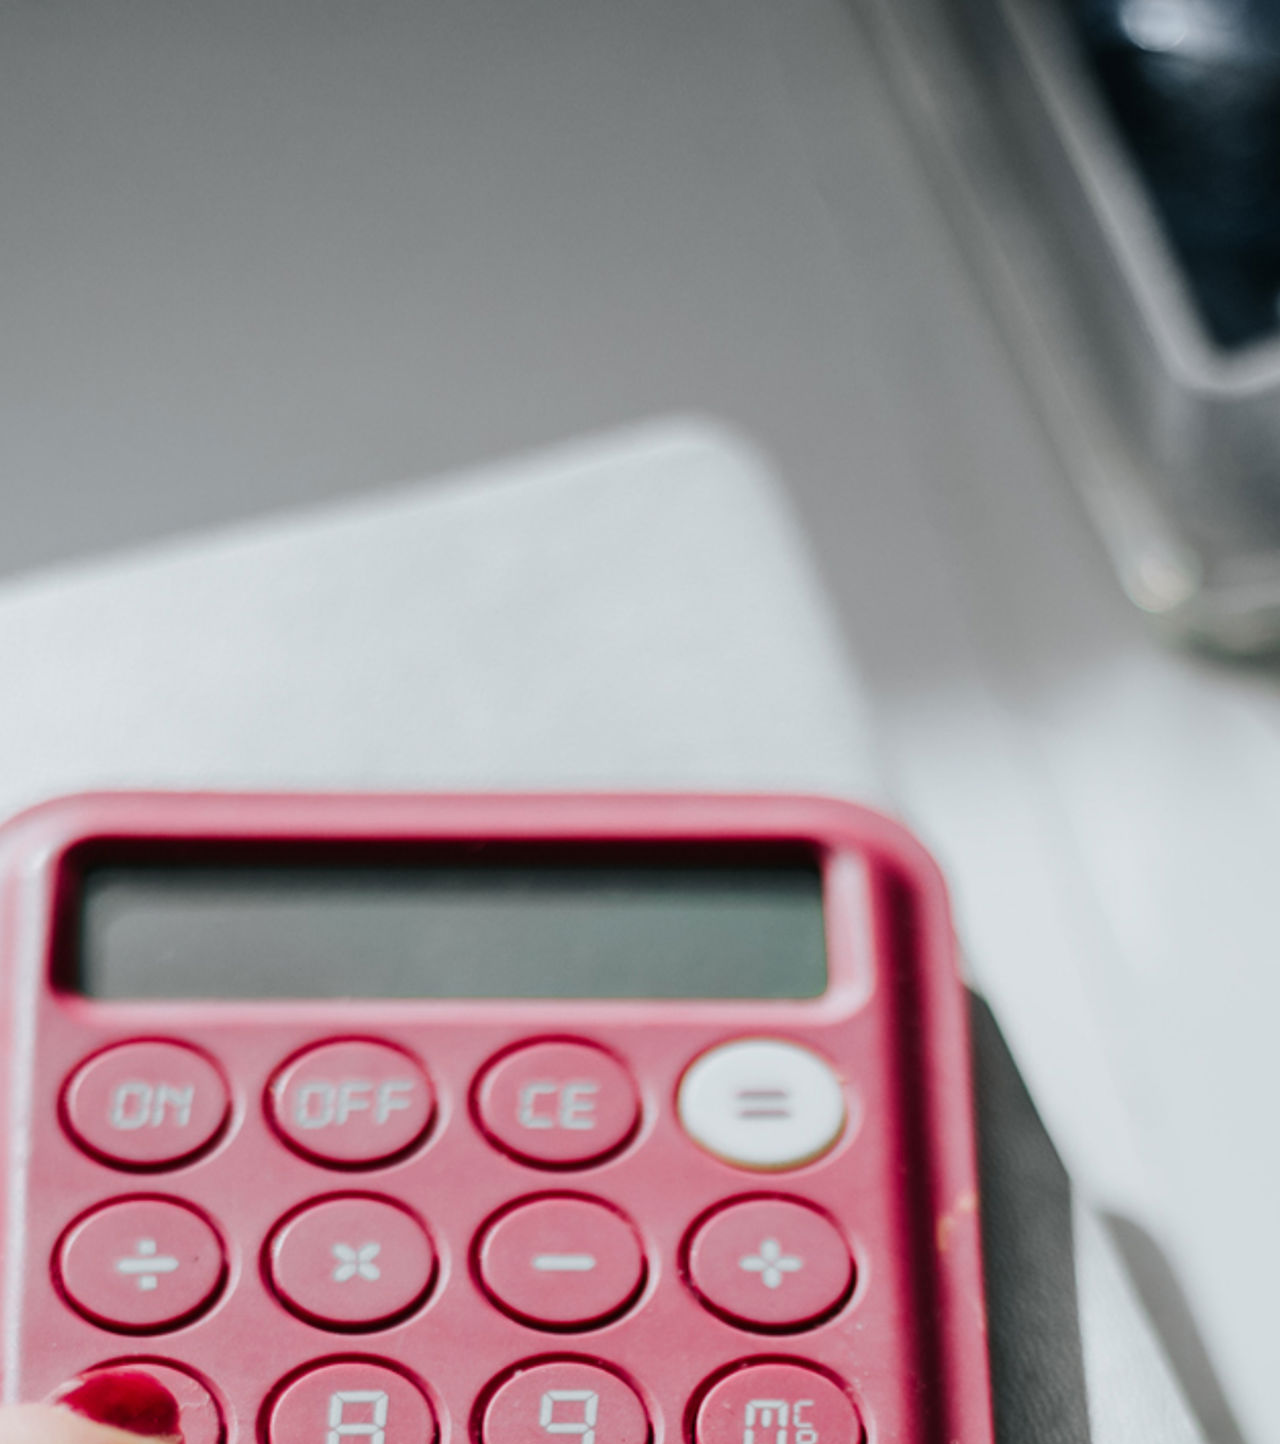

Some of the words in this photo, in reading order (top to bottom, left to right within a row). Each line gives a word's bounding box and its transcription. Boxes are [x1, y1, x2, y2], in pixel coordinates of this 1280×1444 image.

[110, 1082, 195, 1130] ON
[294, 1080, 415, 1130] OFF
[517, 1082, 599, 1131] CE
